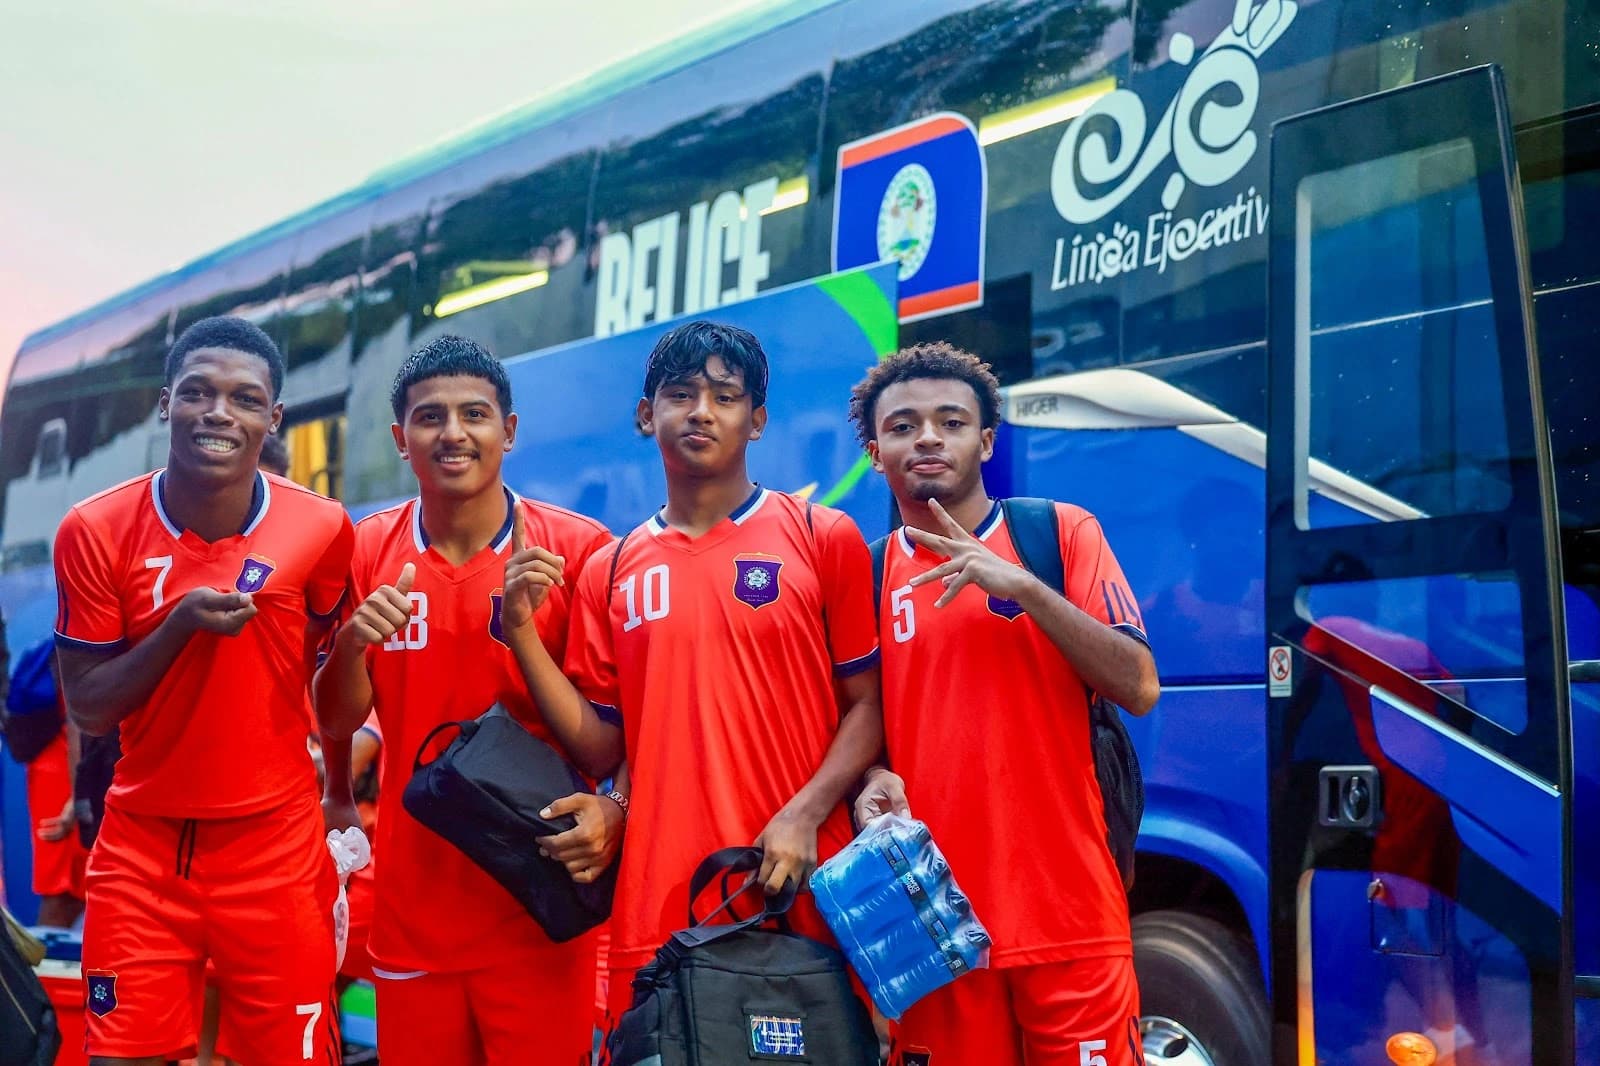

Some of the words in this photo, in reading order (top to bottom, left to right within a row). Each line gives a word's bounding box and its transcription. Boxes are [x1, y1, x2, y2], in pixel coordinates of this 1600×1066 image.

[594, 176, 779, 338] BELICE
[144, 555, 173, 611] 7
[619, 564, 670, 633] 10
[891, 584, 916, 643] 5
[296, 1001, 322, 1060] 7
